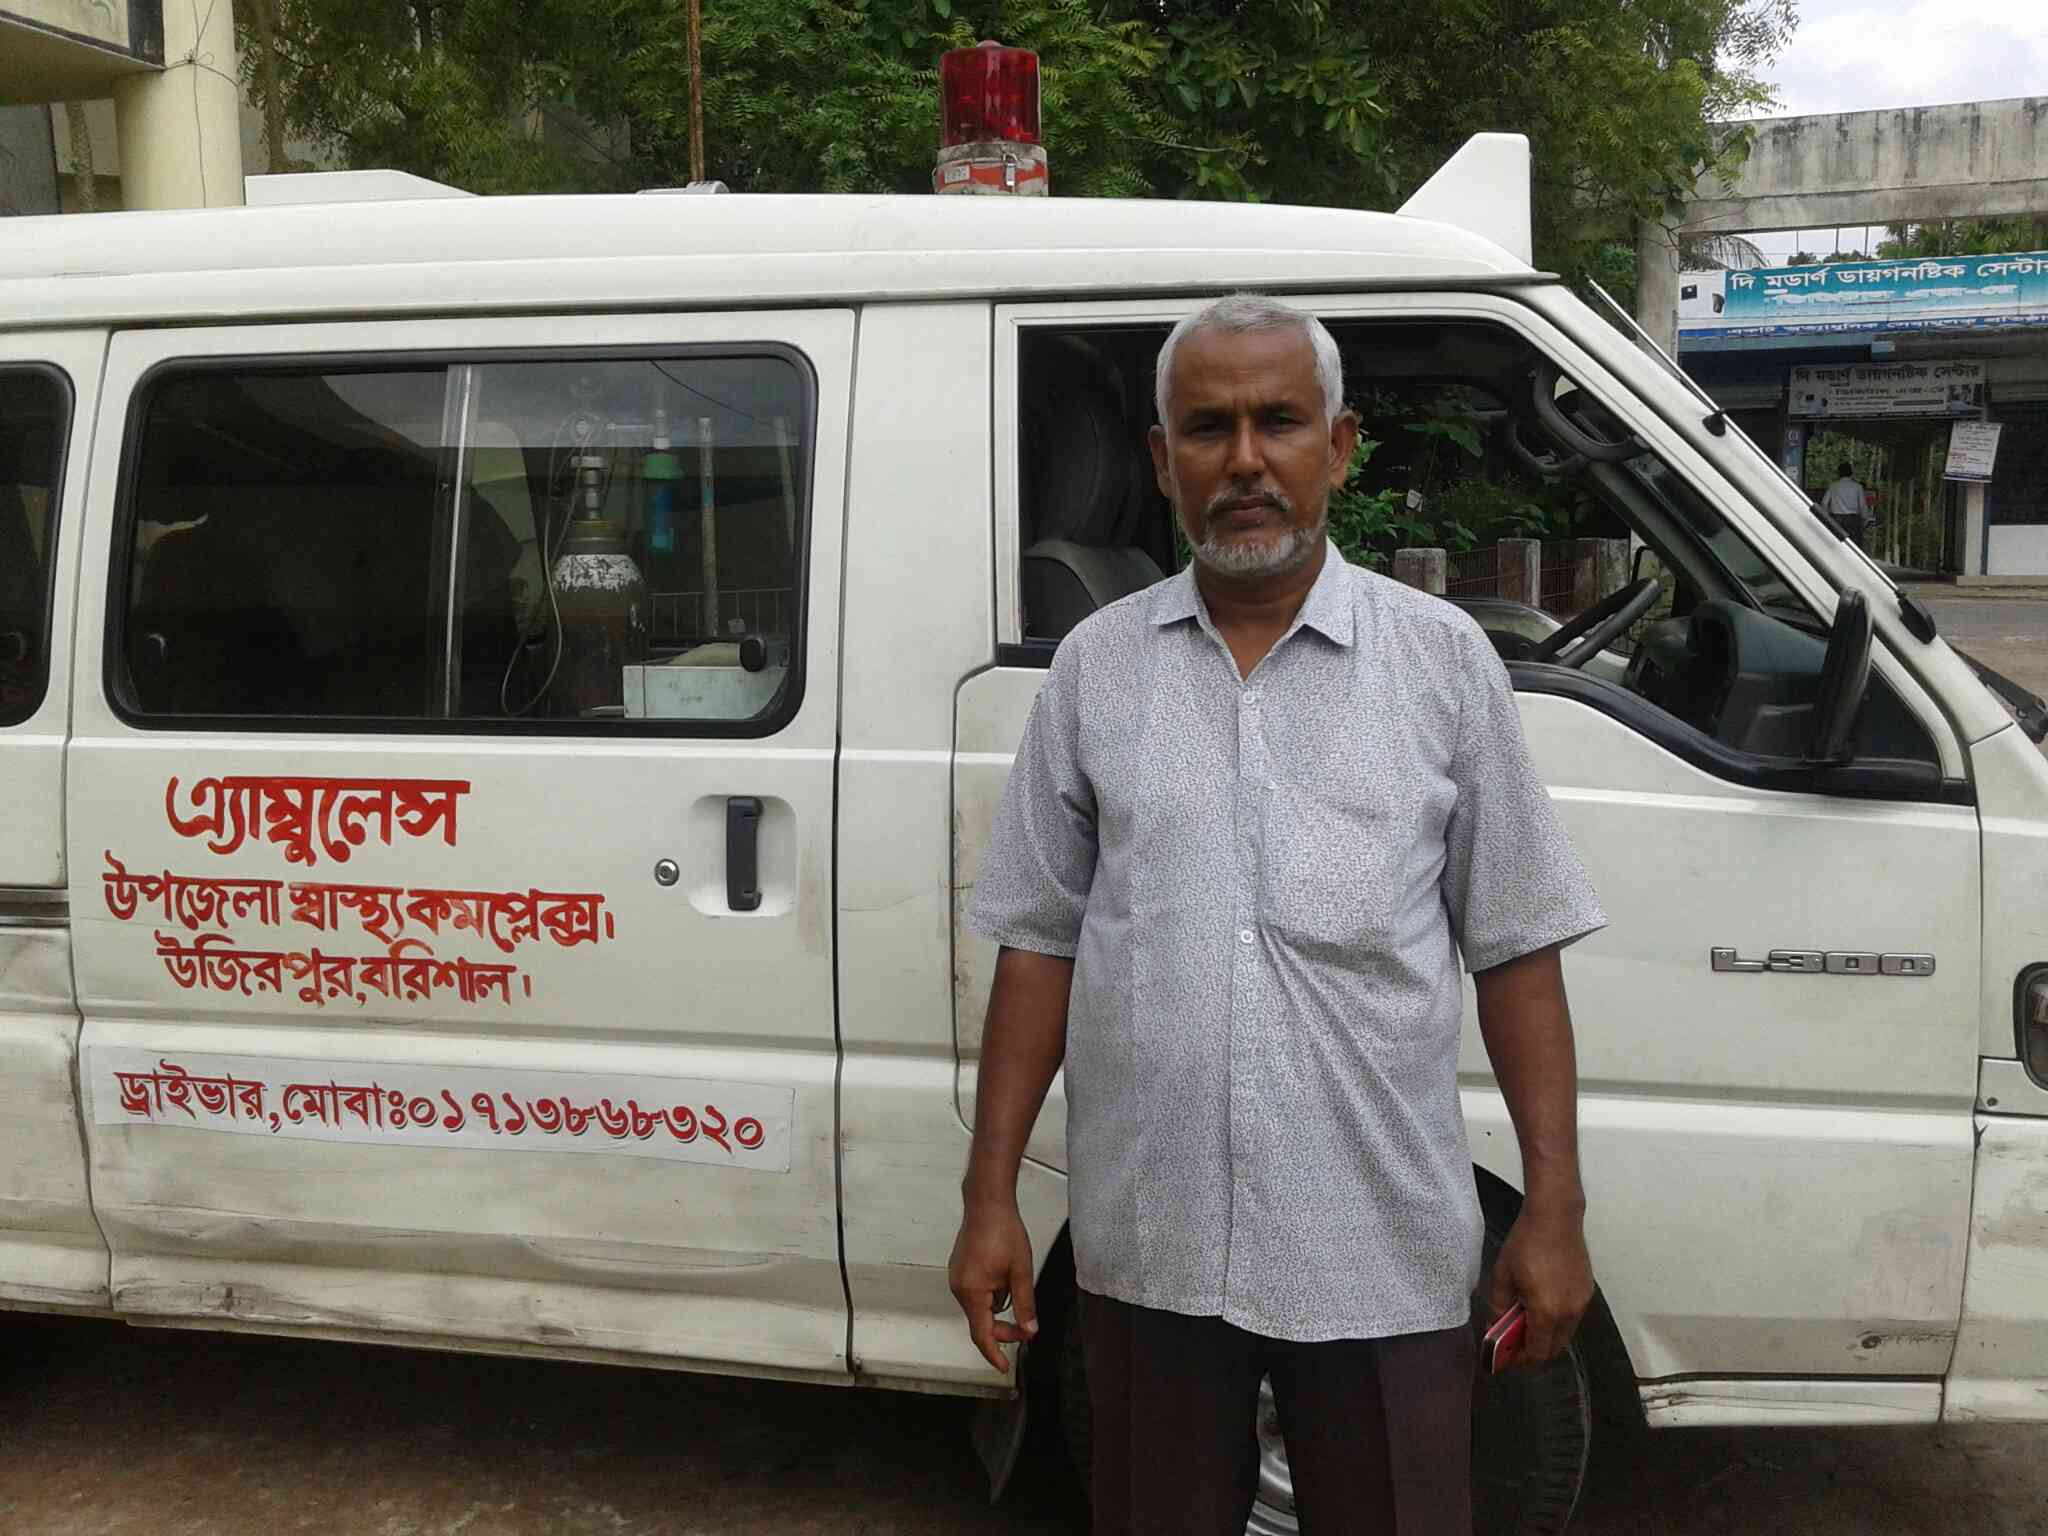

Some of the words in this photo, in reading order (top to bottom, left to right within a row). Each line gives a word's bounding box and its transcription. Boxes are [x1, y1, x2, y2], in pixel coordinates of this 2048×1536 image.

[1729, 272, 1756, 291] দি
[1976, 256, 2048, 278] সেন্টা
[101, 850, 284, 931] উপজেলা
[288, 881, 405, 944] স্বাস্থ্য
[1710, 946, 1936, 977] L300
